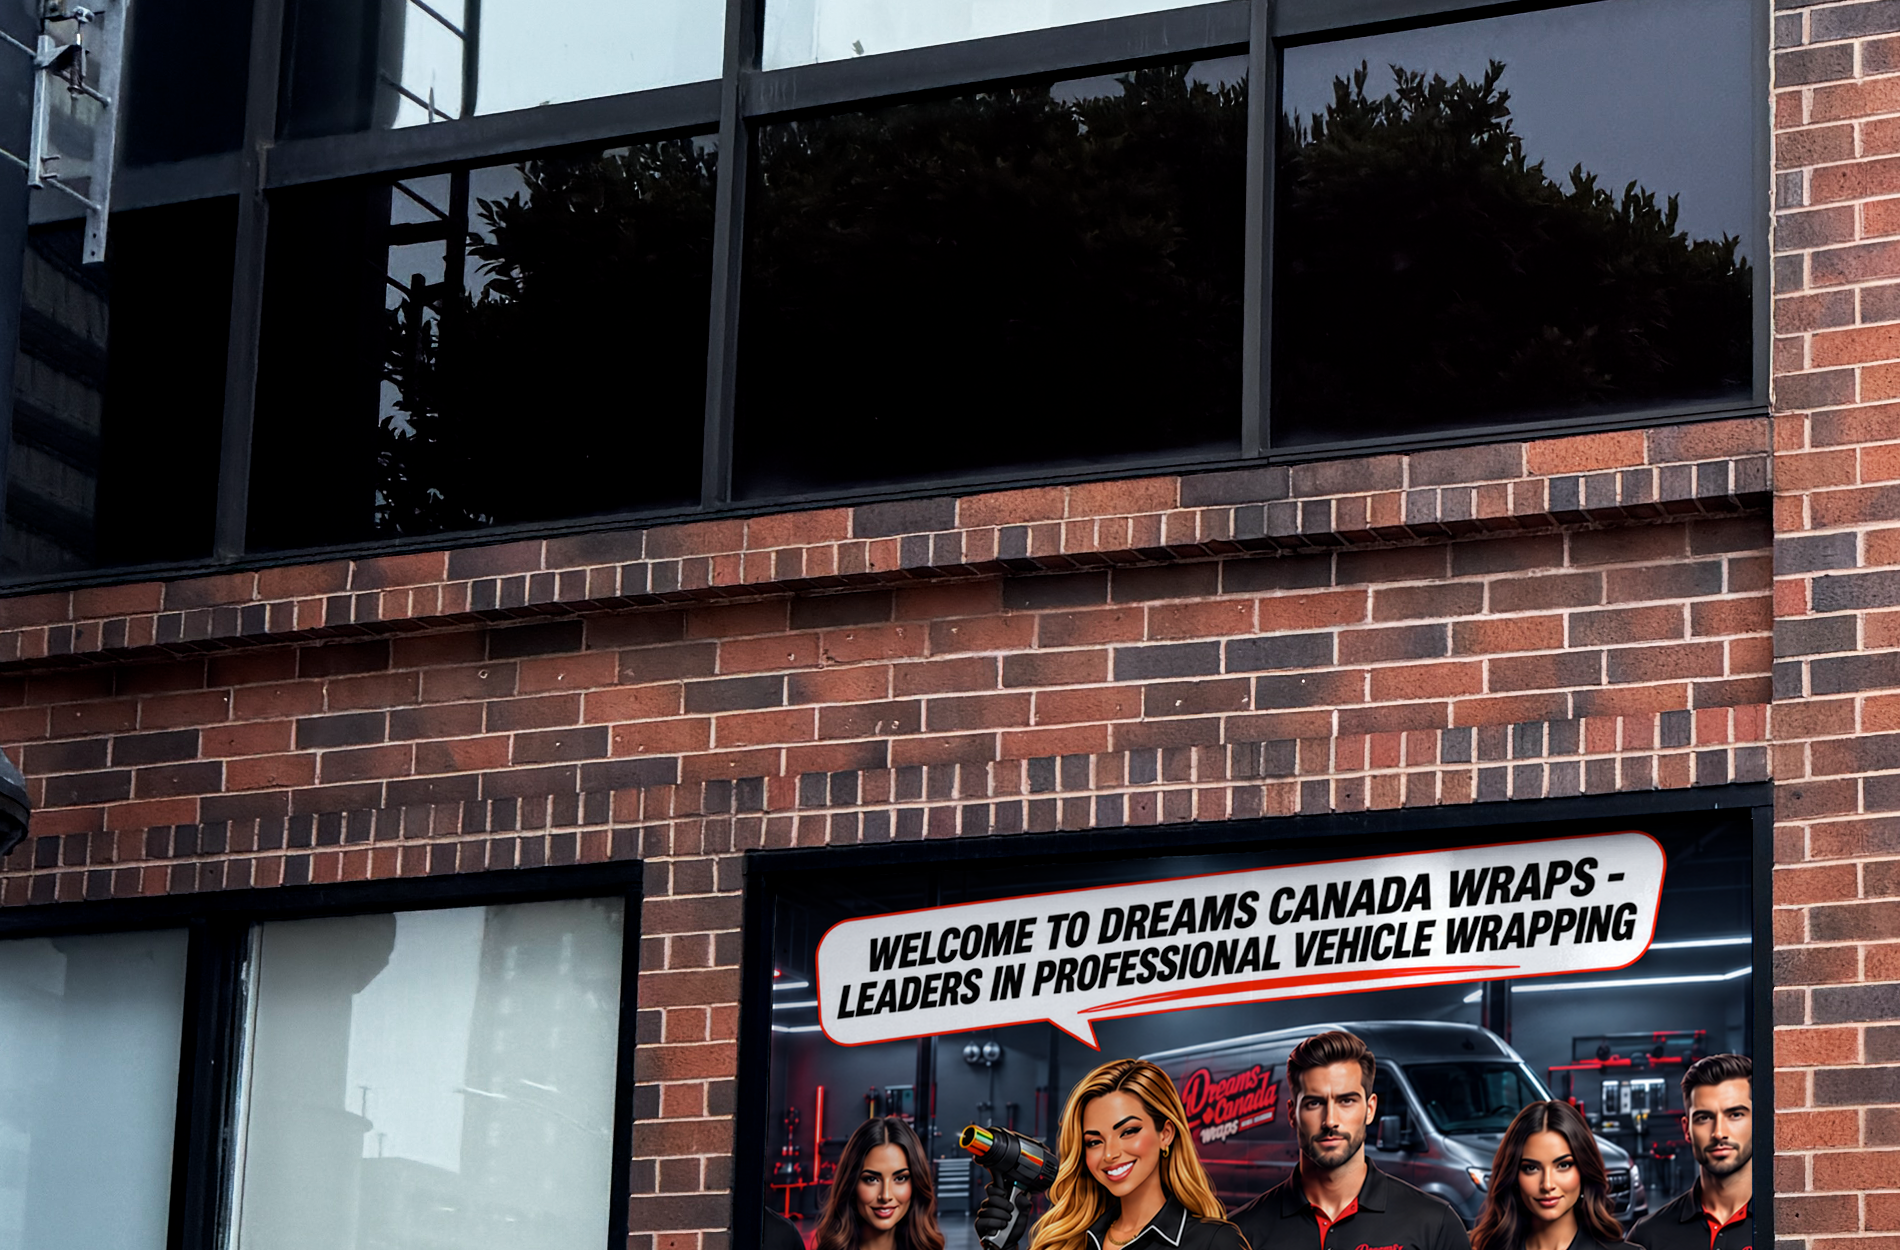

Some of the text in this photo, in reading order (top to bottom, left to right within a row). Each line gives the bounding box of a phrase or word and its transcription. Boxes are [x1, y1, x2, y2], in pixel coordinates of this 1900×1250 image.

[869, 916, 1038, 973] WELCOME
[1047, 910, 1091, 951] TO
[1097, 890, 1260, 945] DREAMS
[1268, 872, 1432, 926] CANADA
[1449, 856, 1599, 909] WRAPS
[836, 902, 1638, 1020] LEADERS IN PROFESSIONAL VEHICLE WRAPPING
[1181, 1064, 1261, 1118] Dreams
[1214, 1070, 1278, 1125] Canada
